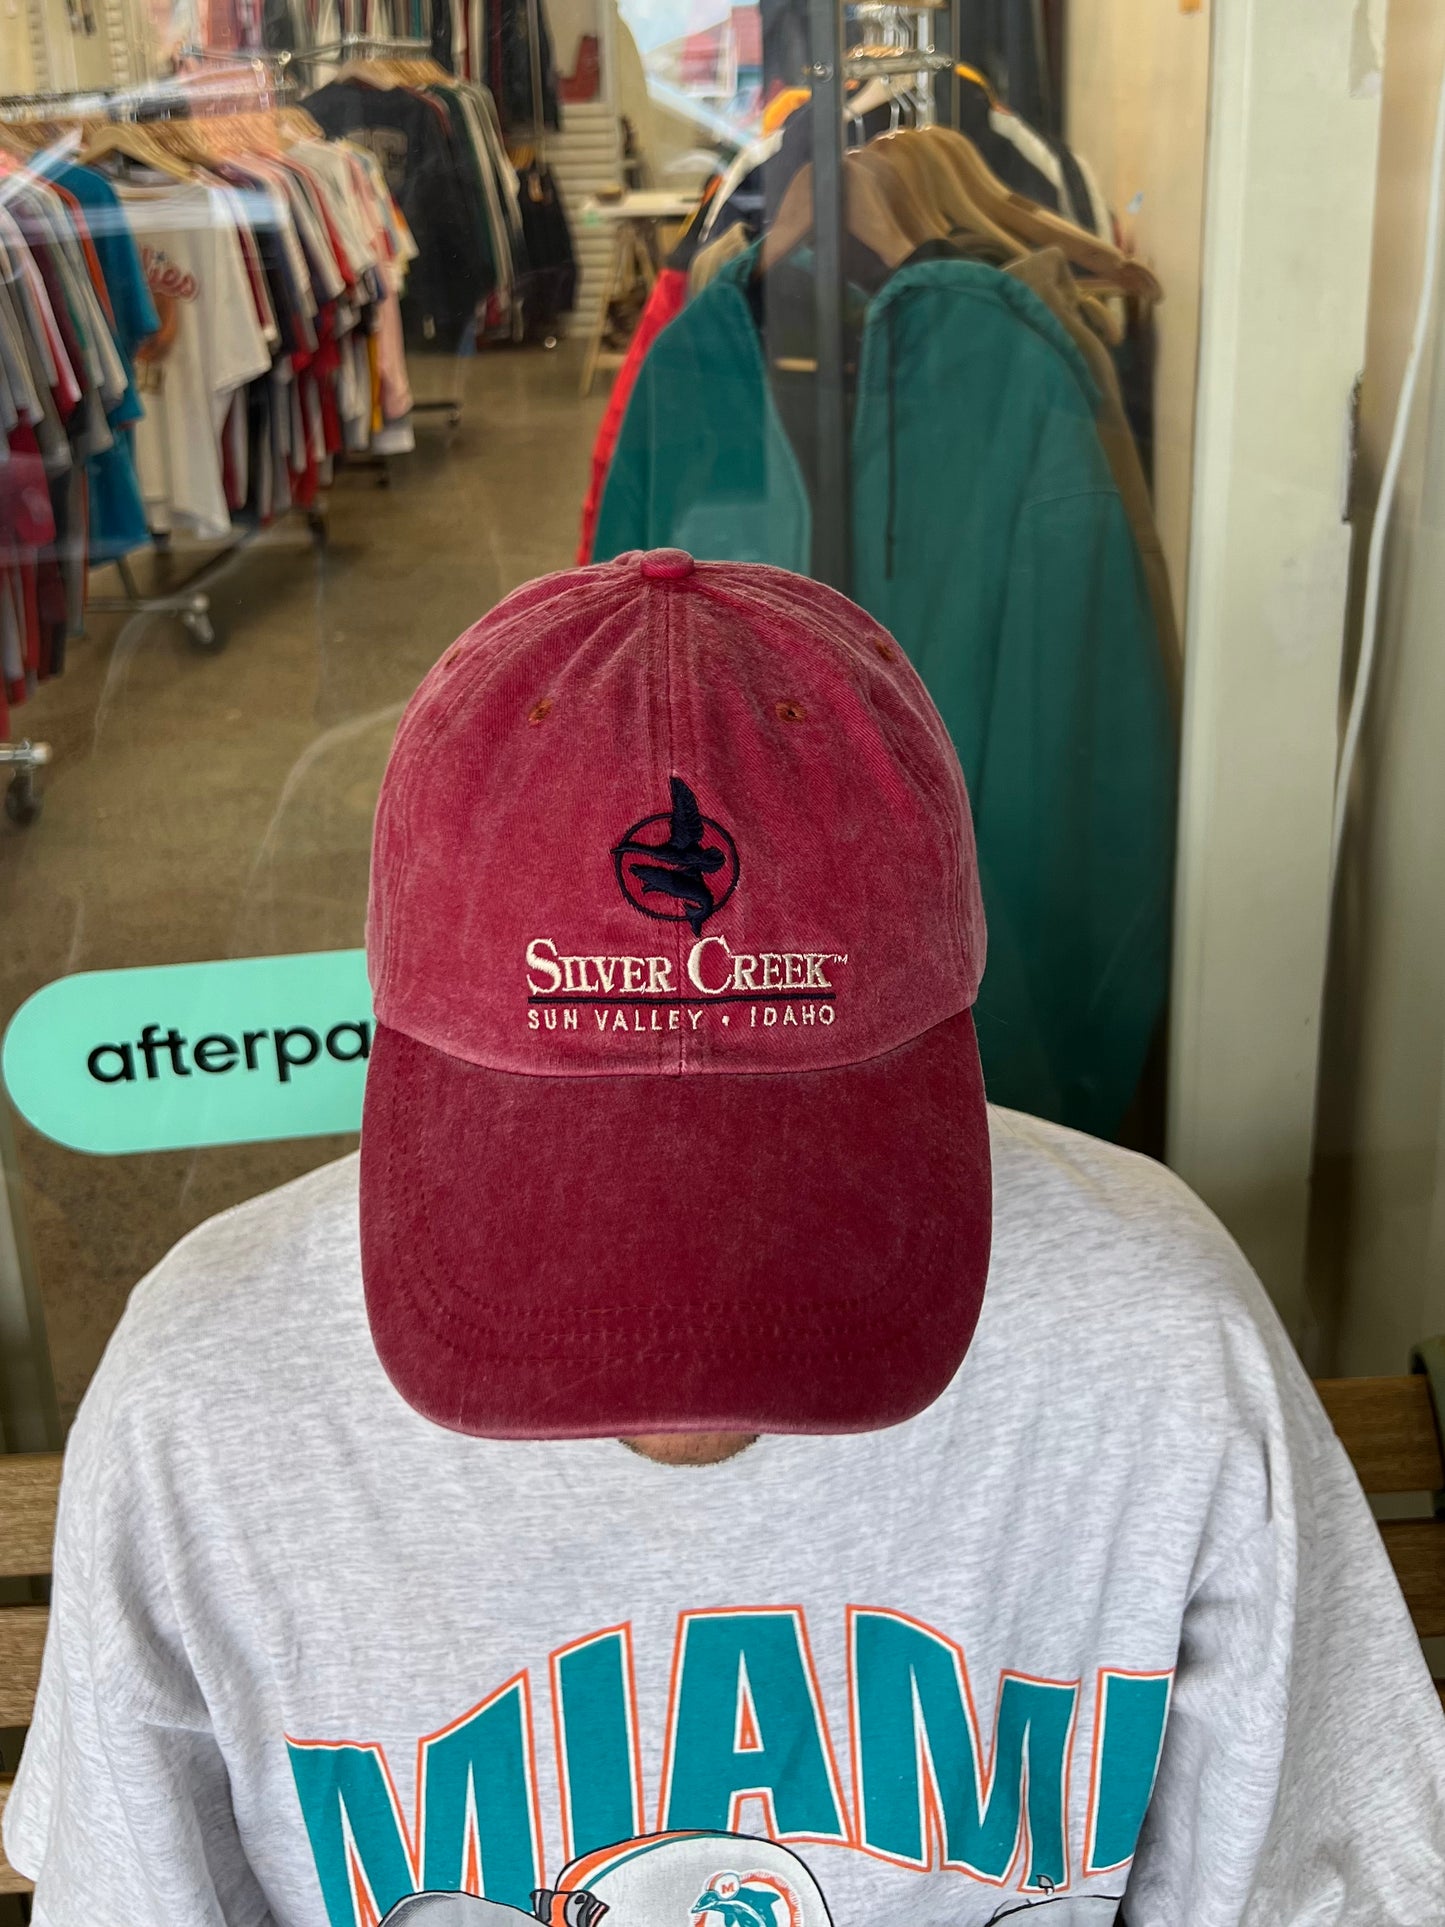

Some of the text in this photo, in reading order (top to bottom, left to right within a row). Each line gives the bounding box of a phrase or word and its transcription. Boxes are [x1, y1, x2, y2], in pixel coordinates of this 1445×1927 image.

[526, 938, 677, 995] SILVER
[527, 1008, 578, 1030] SUN
[595, 1008, 703, 1031] VALLEY
[750, 1004, 836, 1027] IDAHO
[87, 1019, 373, 1083] afterpa
[283, 1603, 1176, 1927] MIAMI
[721, 1882, 735, 1895] M
